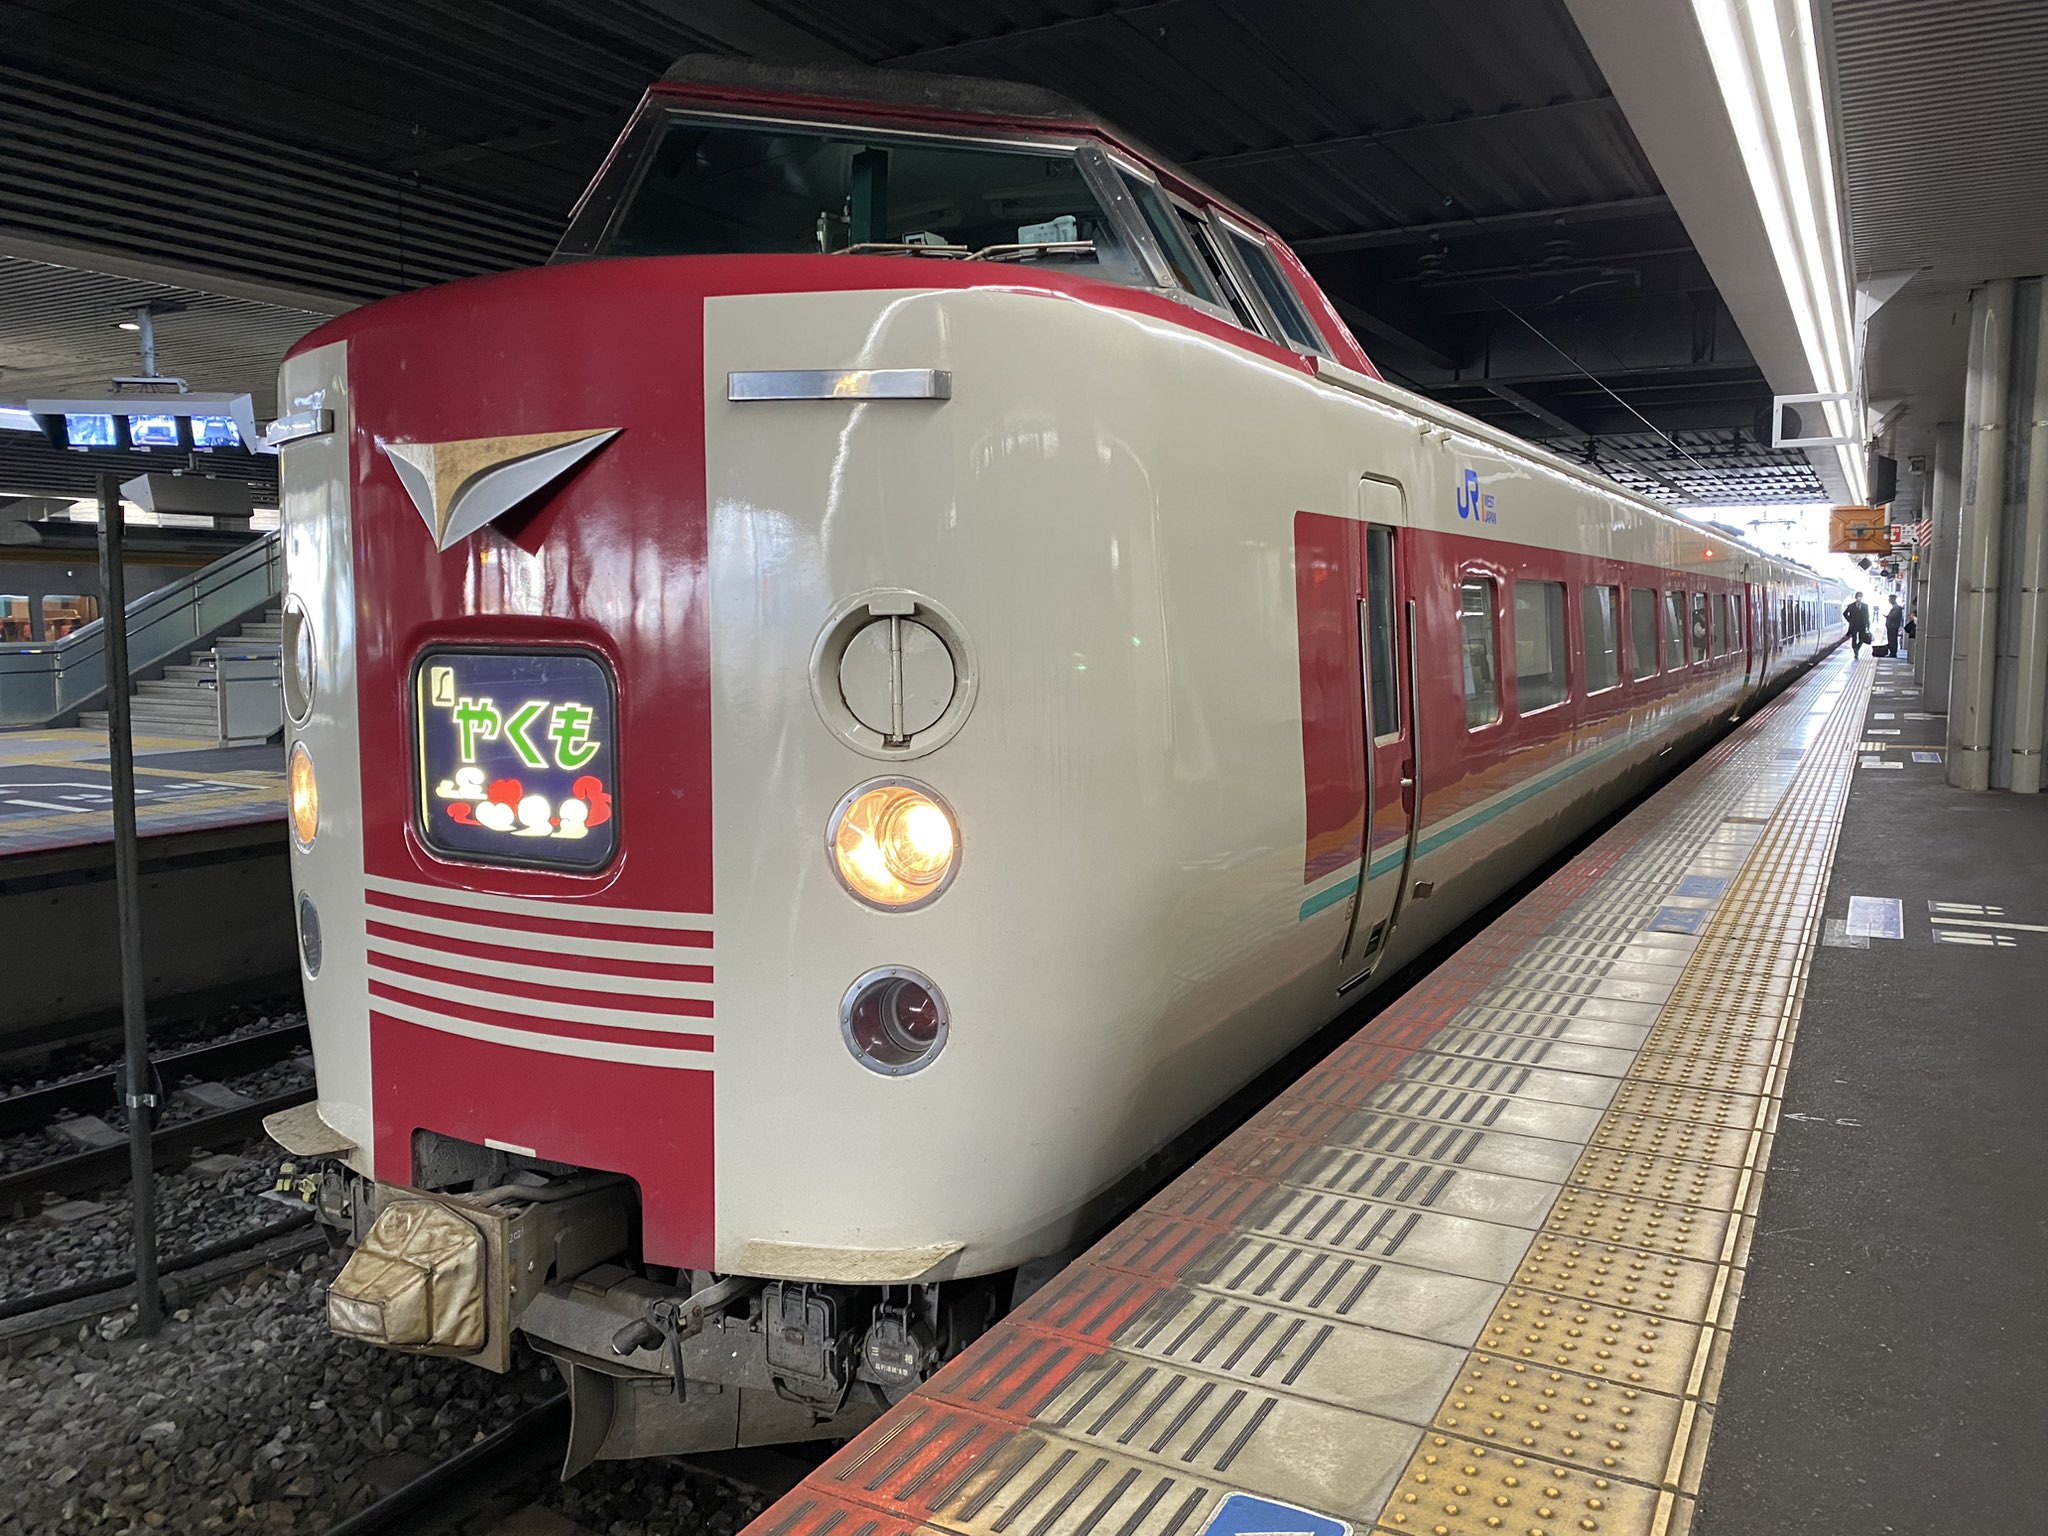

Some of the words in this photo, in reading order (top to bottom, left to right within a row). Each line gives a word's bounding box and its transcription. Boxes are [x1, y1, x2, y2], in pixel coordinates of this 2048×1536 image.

[1456, 468, 1480, 521] JR
[1484, 494, 1494, 508] WEST
[1485, 510, 1497, 525] JAPAN
[454, 698, 600, 771] やくも
